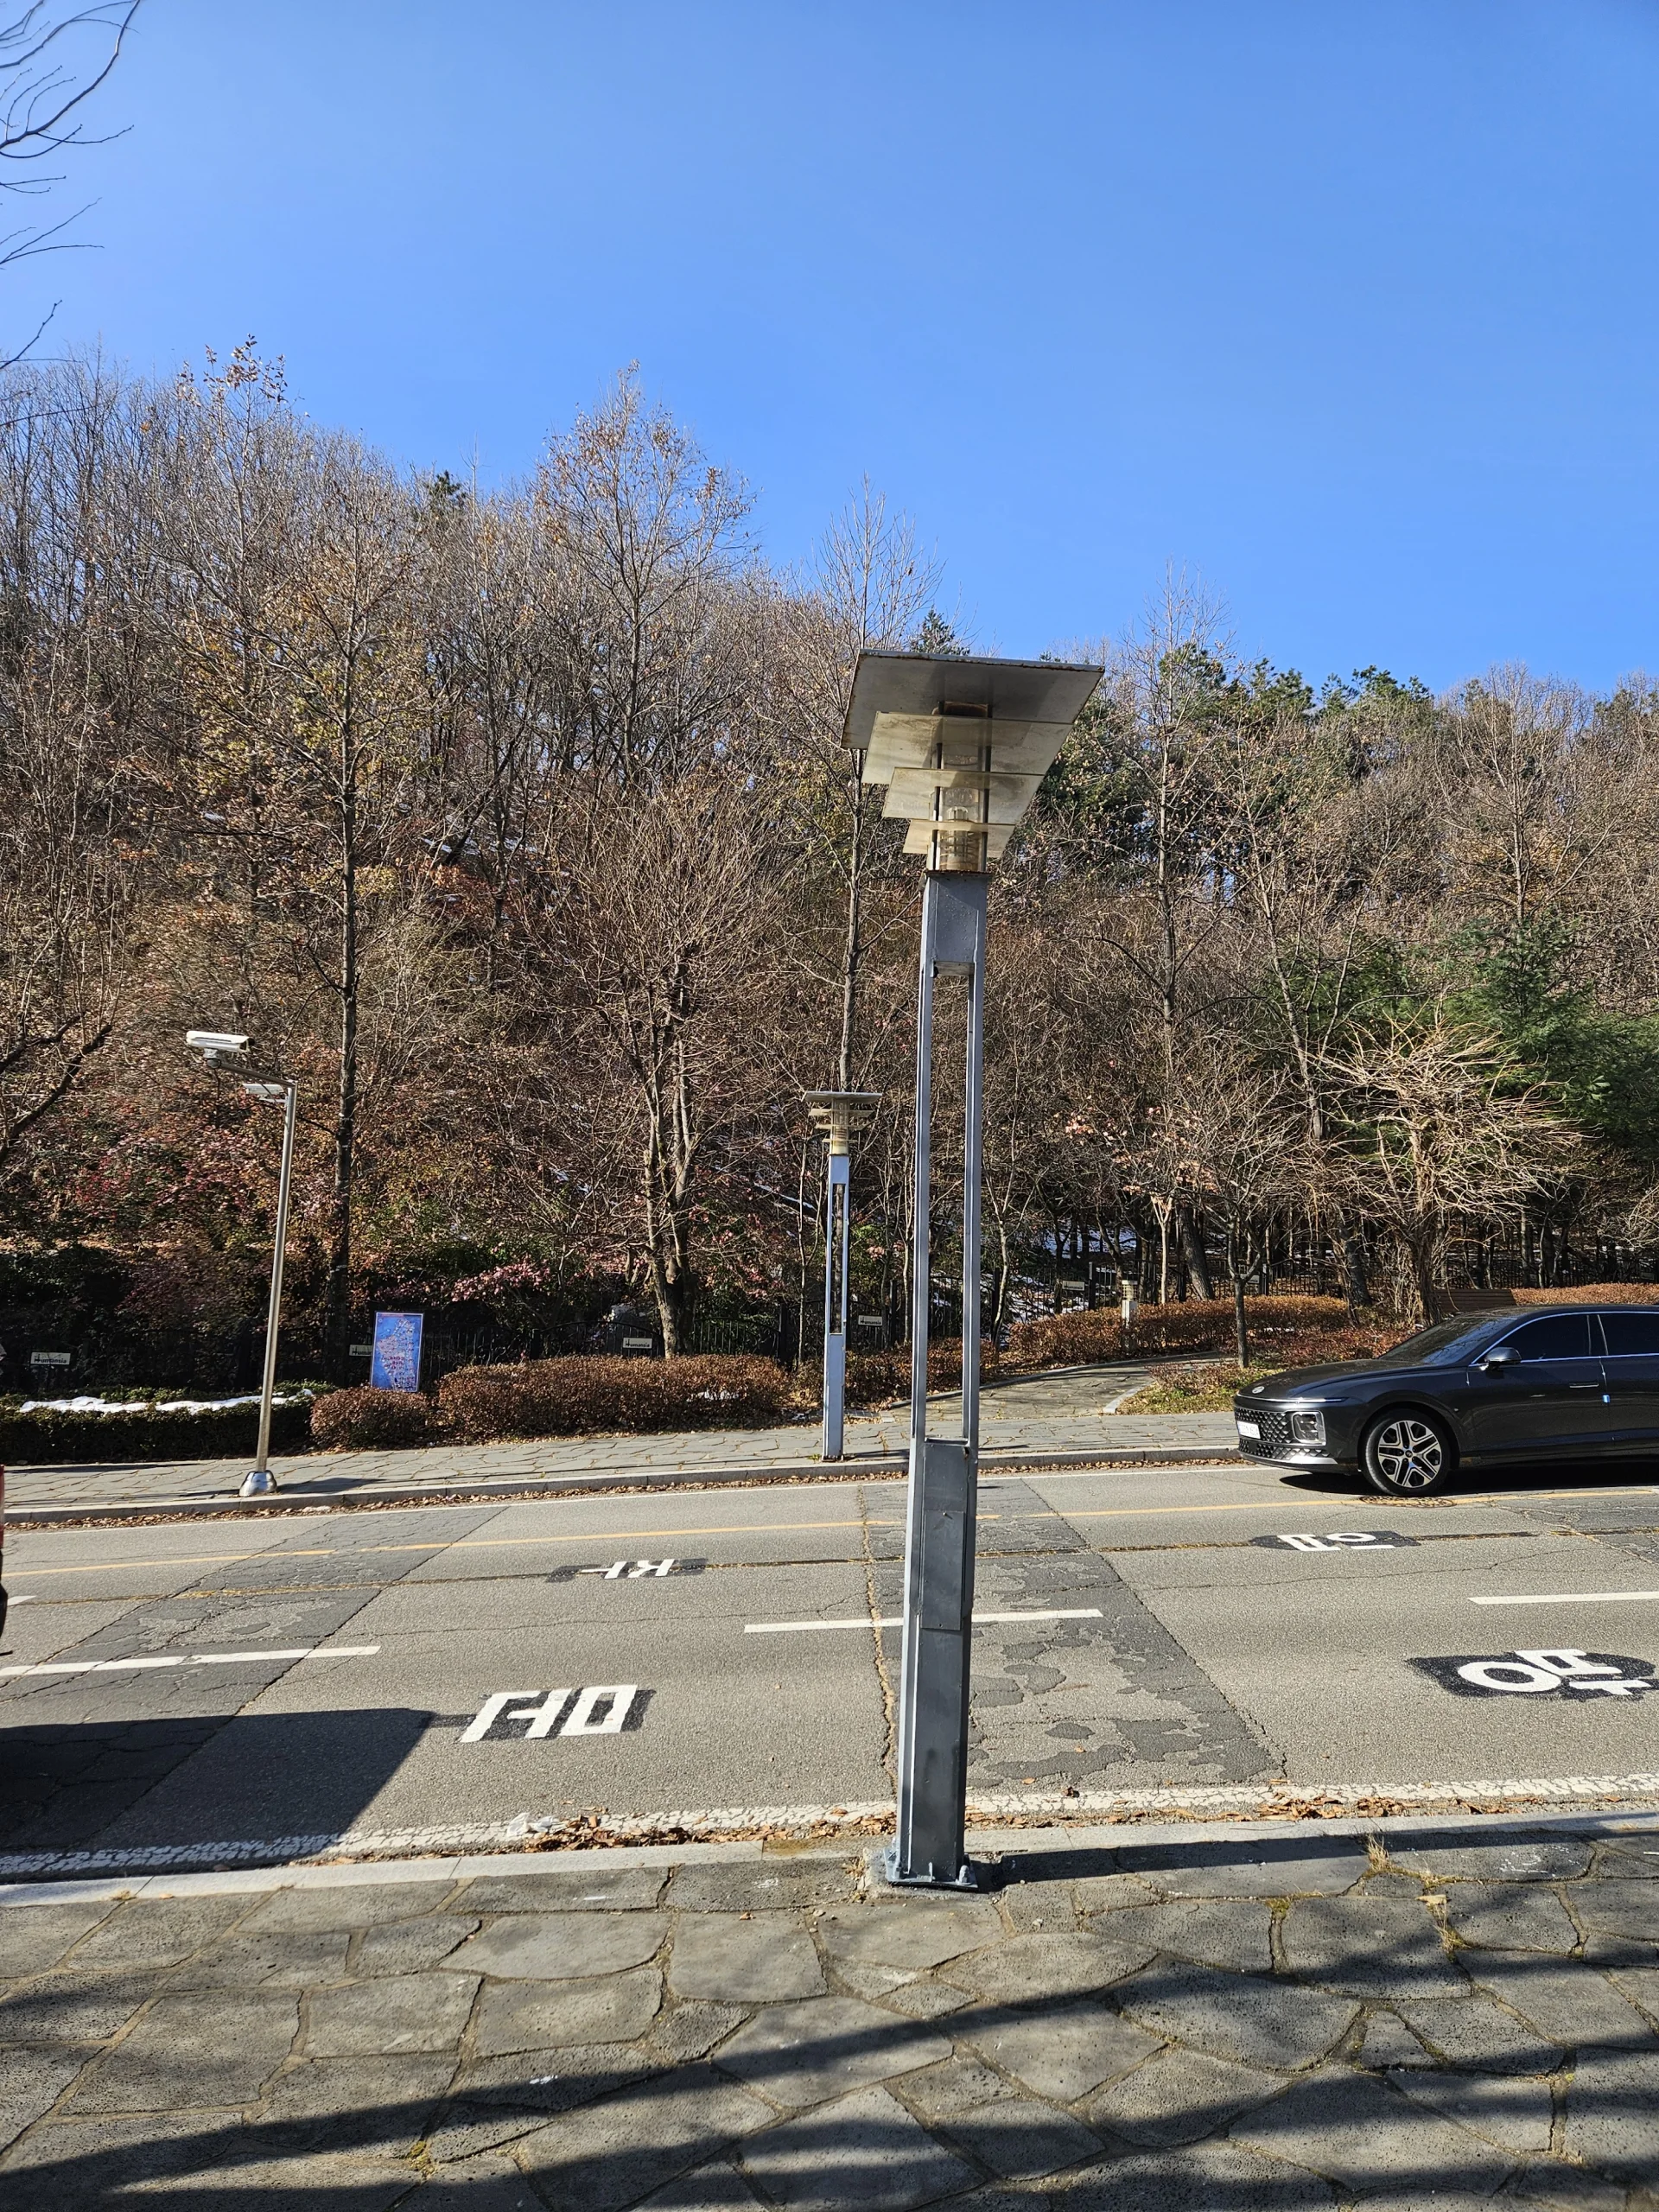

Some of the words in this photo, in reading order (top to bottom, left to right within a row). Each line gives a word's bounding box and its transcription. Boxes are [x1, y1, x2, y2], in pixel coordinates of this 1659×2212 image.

[625, 1338, 651, 1348] Humansia
[34, 1353, 67, 1363] Humansia
[1457, 1648, 1651, 1696] 방
[459, 1684, 639, 1743] 문
